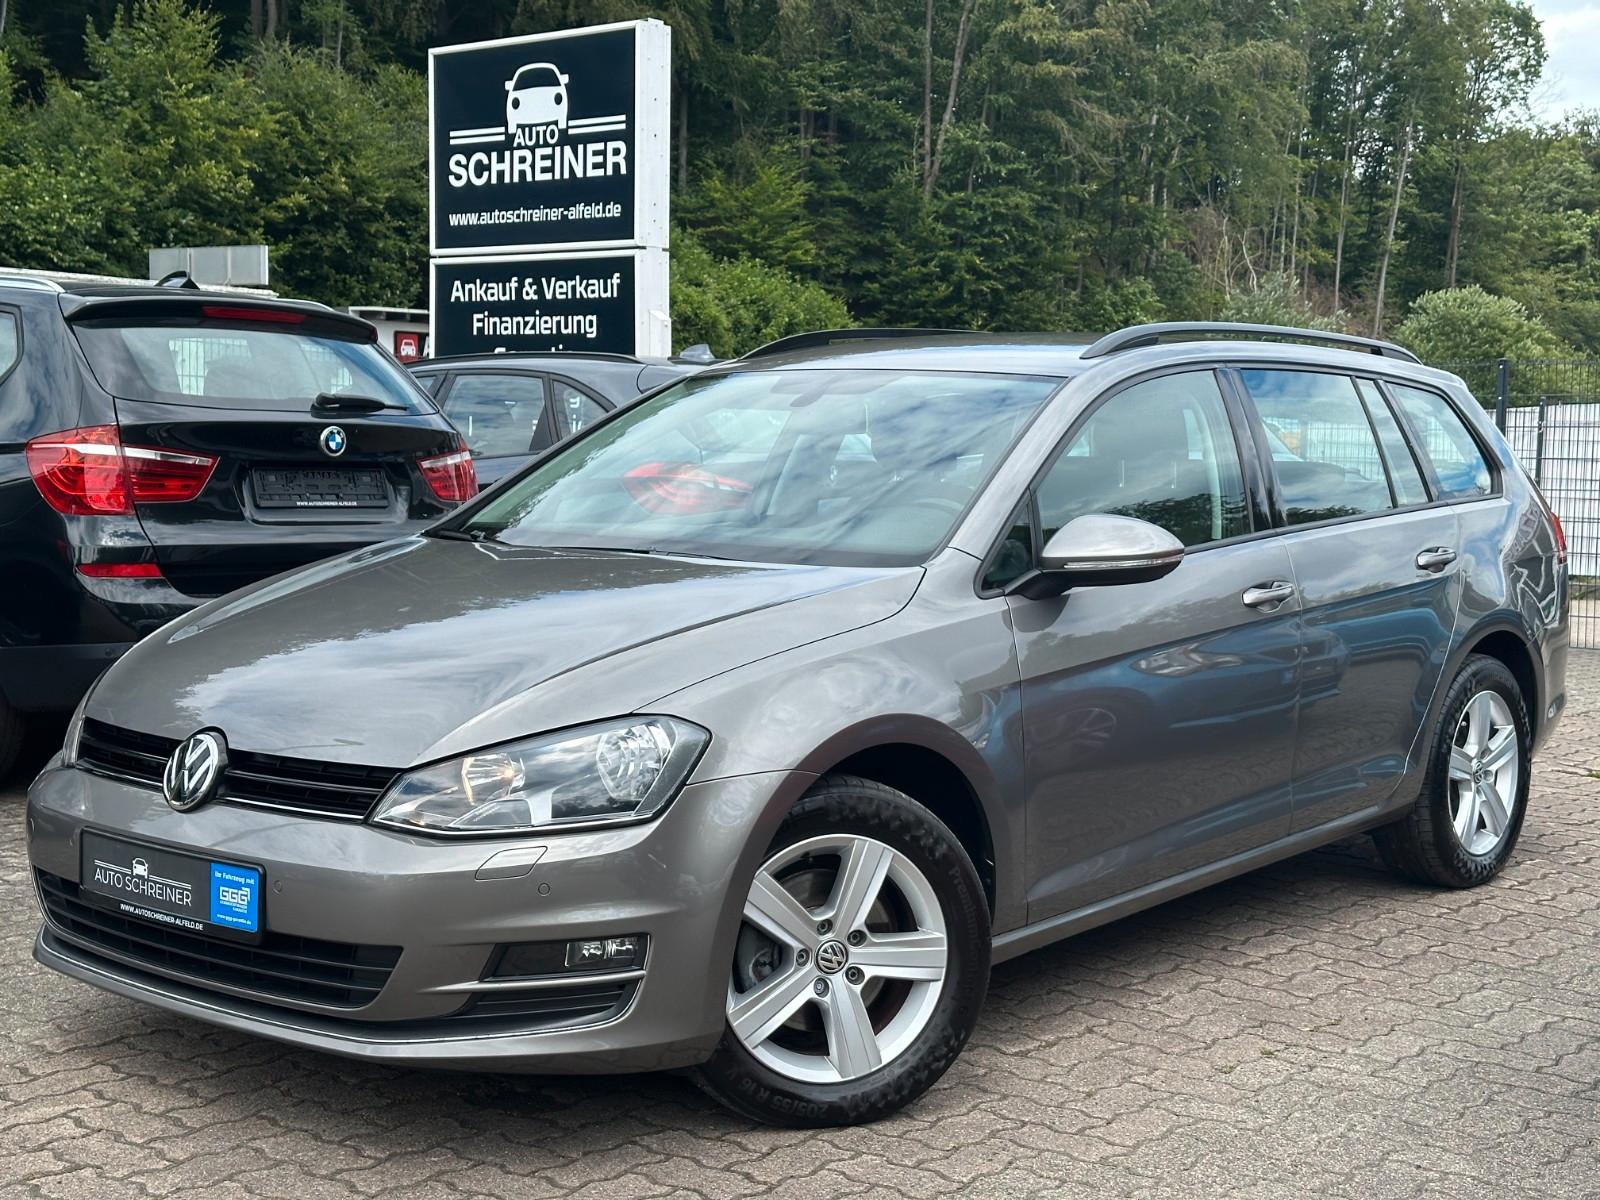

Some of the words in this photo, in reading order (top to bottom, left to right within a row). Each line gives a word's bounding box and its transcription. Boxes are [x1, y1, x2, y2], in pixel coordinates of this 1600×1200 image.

[513, 124, 559, 147] AUTO
[448, 140, 627, 188] SCHREINER
[449, 201, 622, 227] www.autoschreiner-alfeld.de
[450, 276, 519, 302] Ankauf
[522, 277, 538, 300] &
[541, 273, 621, 300] Verkauf
[472, 311, 598, 338] Finanzierung
[94, 868, 123, 888] AUTO
[125, 877, 192, 907] SCHREINER
